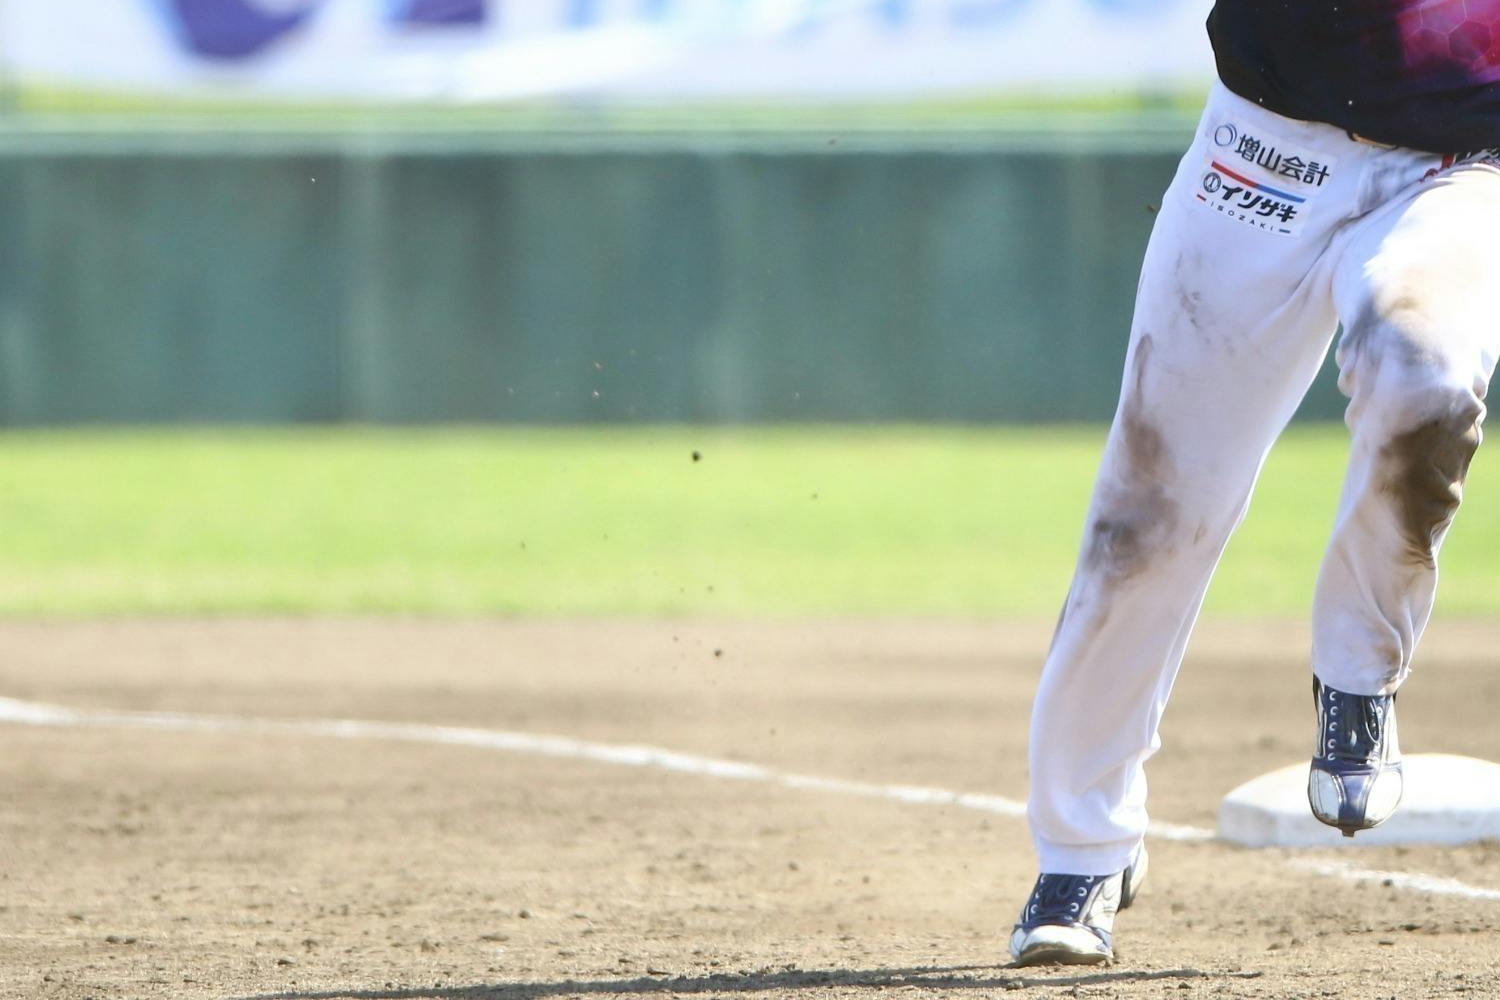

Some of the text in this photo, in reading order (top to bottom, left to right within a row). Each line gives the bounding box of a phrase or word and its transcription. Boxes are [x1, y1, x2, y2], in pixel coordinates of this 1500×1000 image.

[1234, 133, 1330, 186] 増山会計
[1209, 201, 1274, 232] ISOZAKI
[1222, 185, 1297, 223] イソザキ
